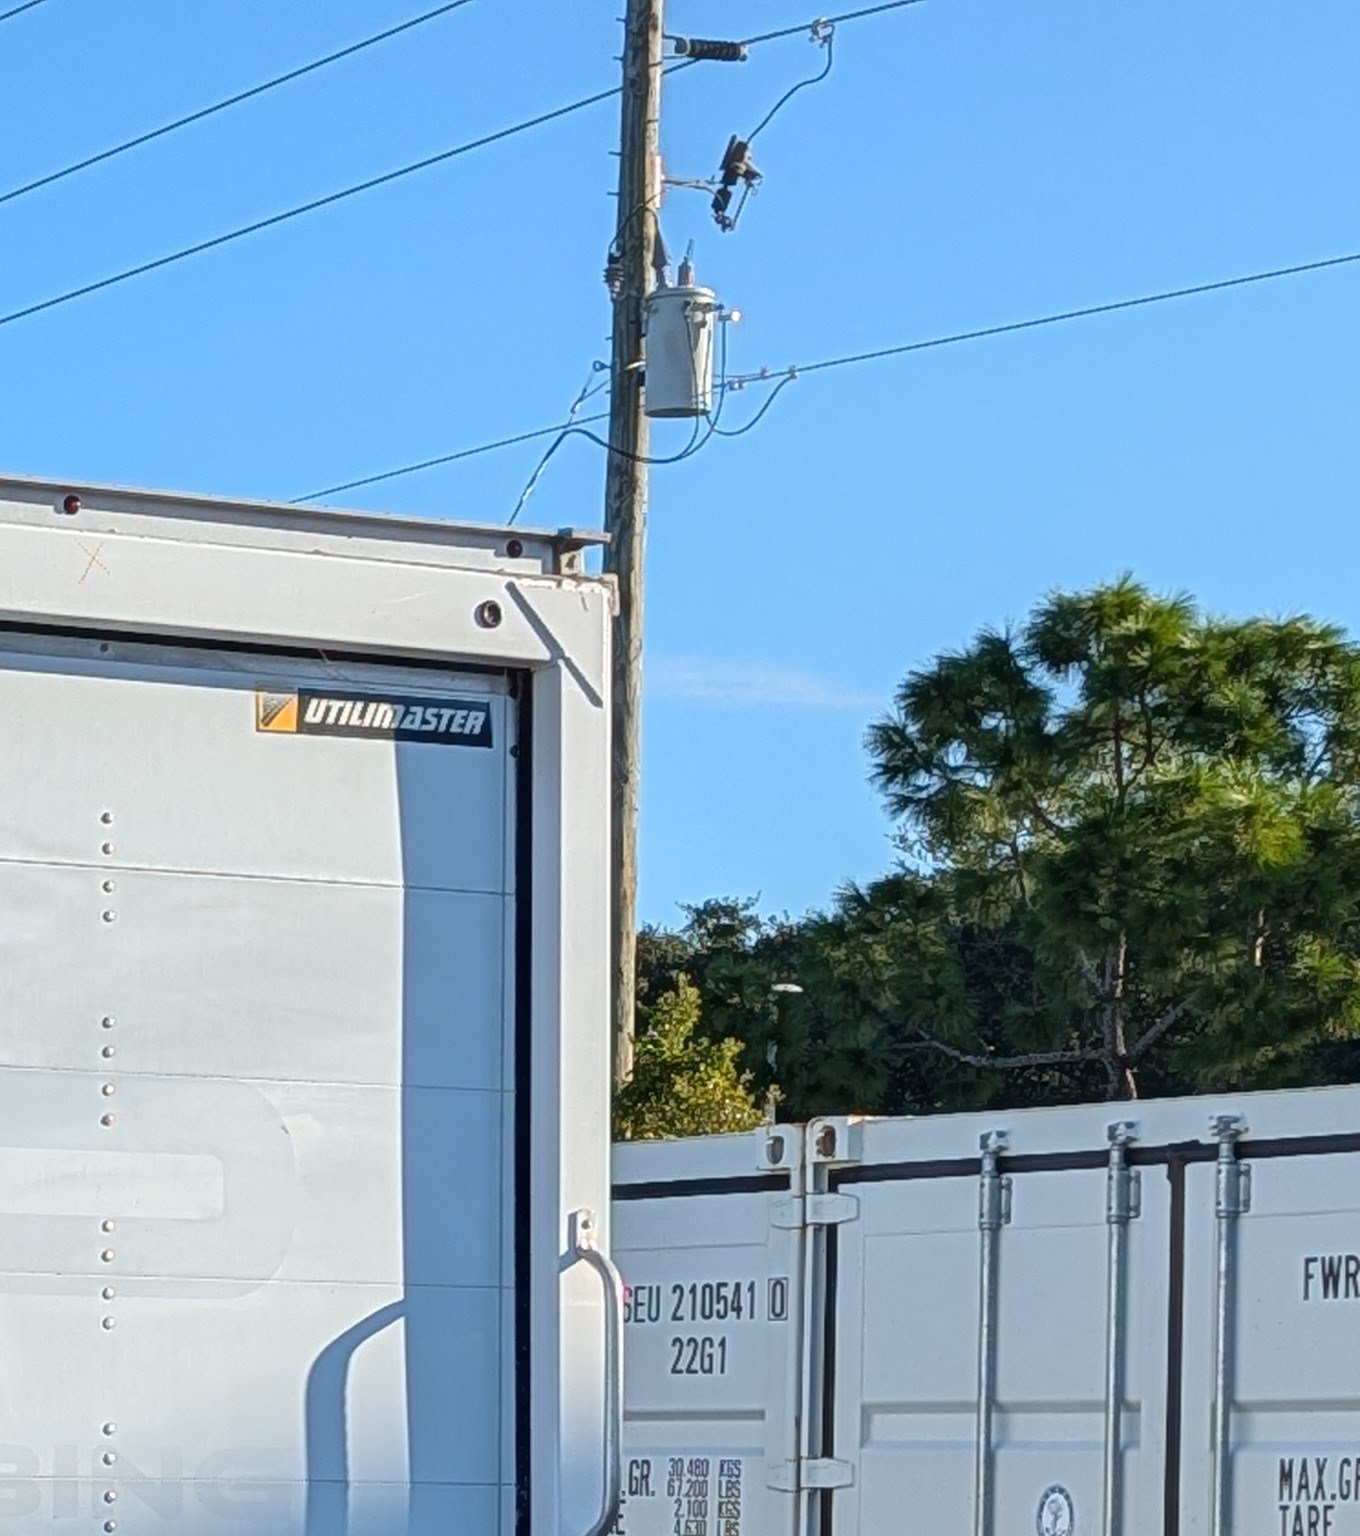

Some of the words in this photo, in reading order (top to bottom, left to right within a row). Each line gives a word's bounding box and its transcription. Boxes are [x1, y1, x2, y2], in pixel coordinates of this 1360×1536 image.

[304, 698, 486, 735] UTILIMASTER
[671, 1280, 756, 1321] 210541
[671, 1336, 726, 1374] 22G1
[621, 1459, 655, 1497] .GR.
[668, 1458, 710, 1478] 30.480
[718, 1459, 742, 1479] KGS
[666, 1478, 708, 1498] 67.200
[718, 1479, 741, 1499] LBS
